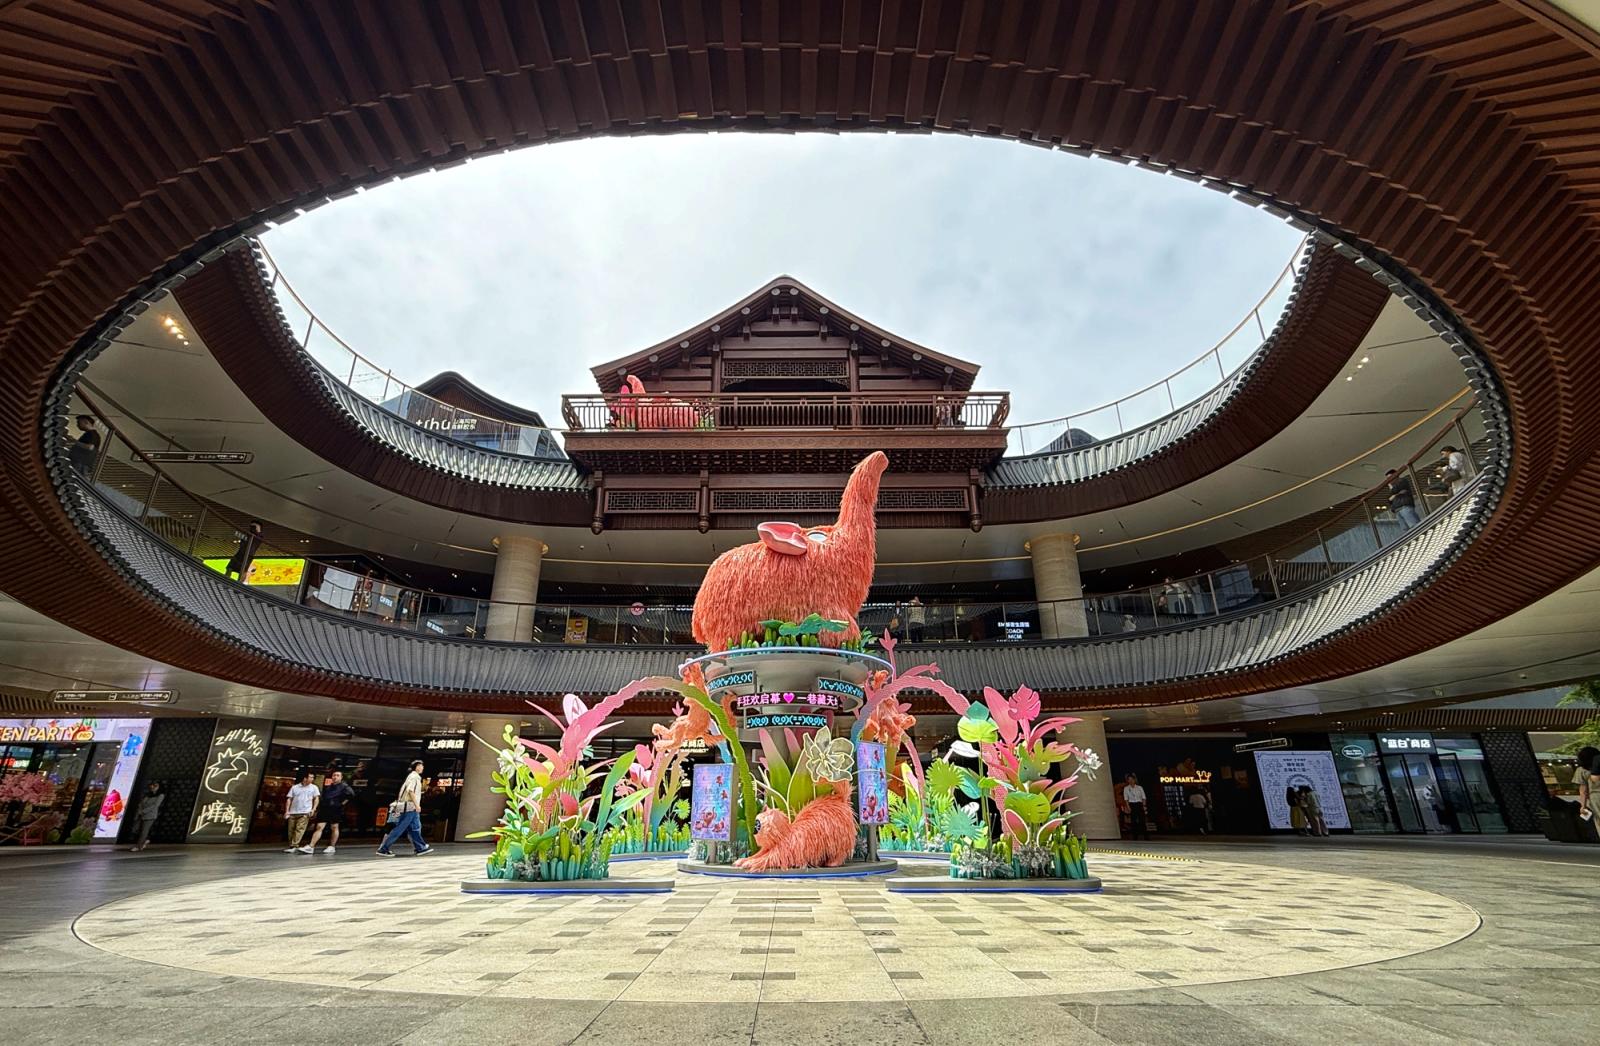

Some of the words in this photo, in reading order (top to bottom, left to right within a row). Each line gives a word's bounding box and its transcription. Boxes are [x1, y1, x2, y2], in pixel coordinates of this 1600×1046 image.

[0, 727, 26, 741] EN
[27, 727, 79, 741] PARTY
[215, 729, 263, 756] ZHIYANG
[190, 800, 247, 835] 止痒商店
